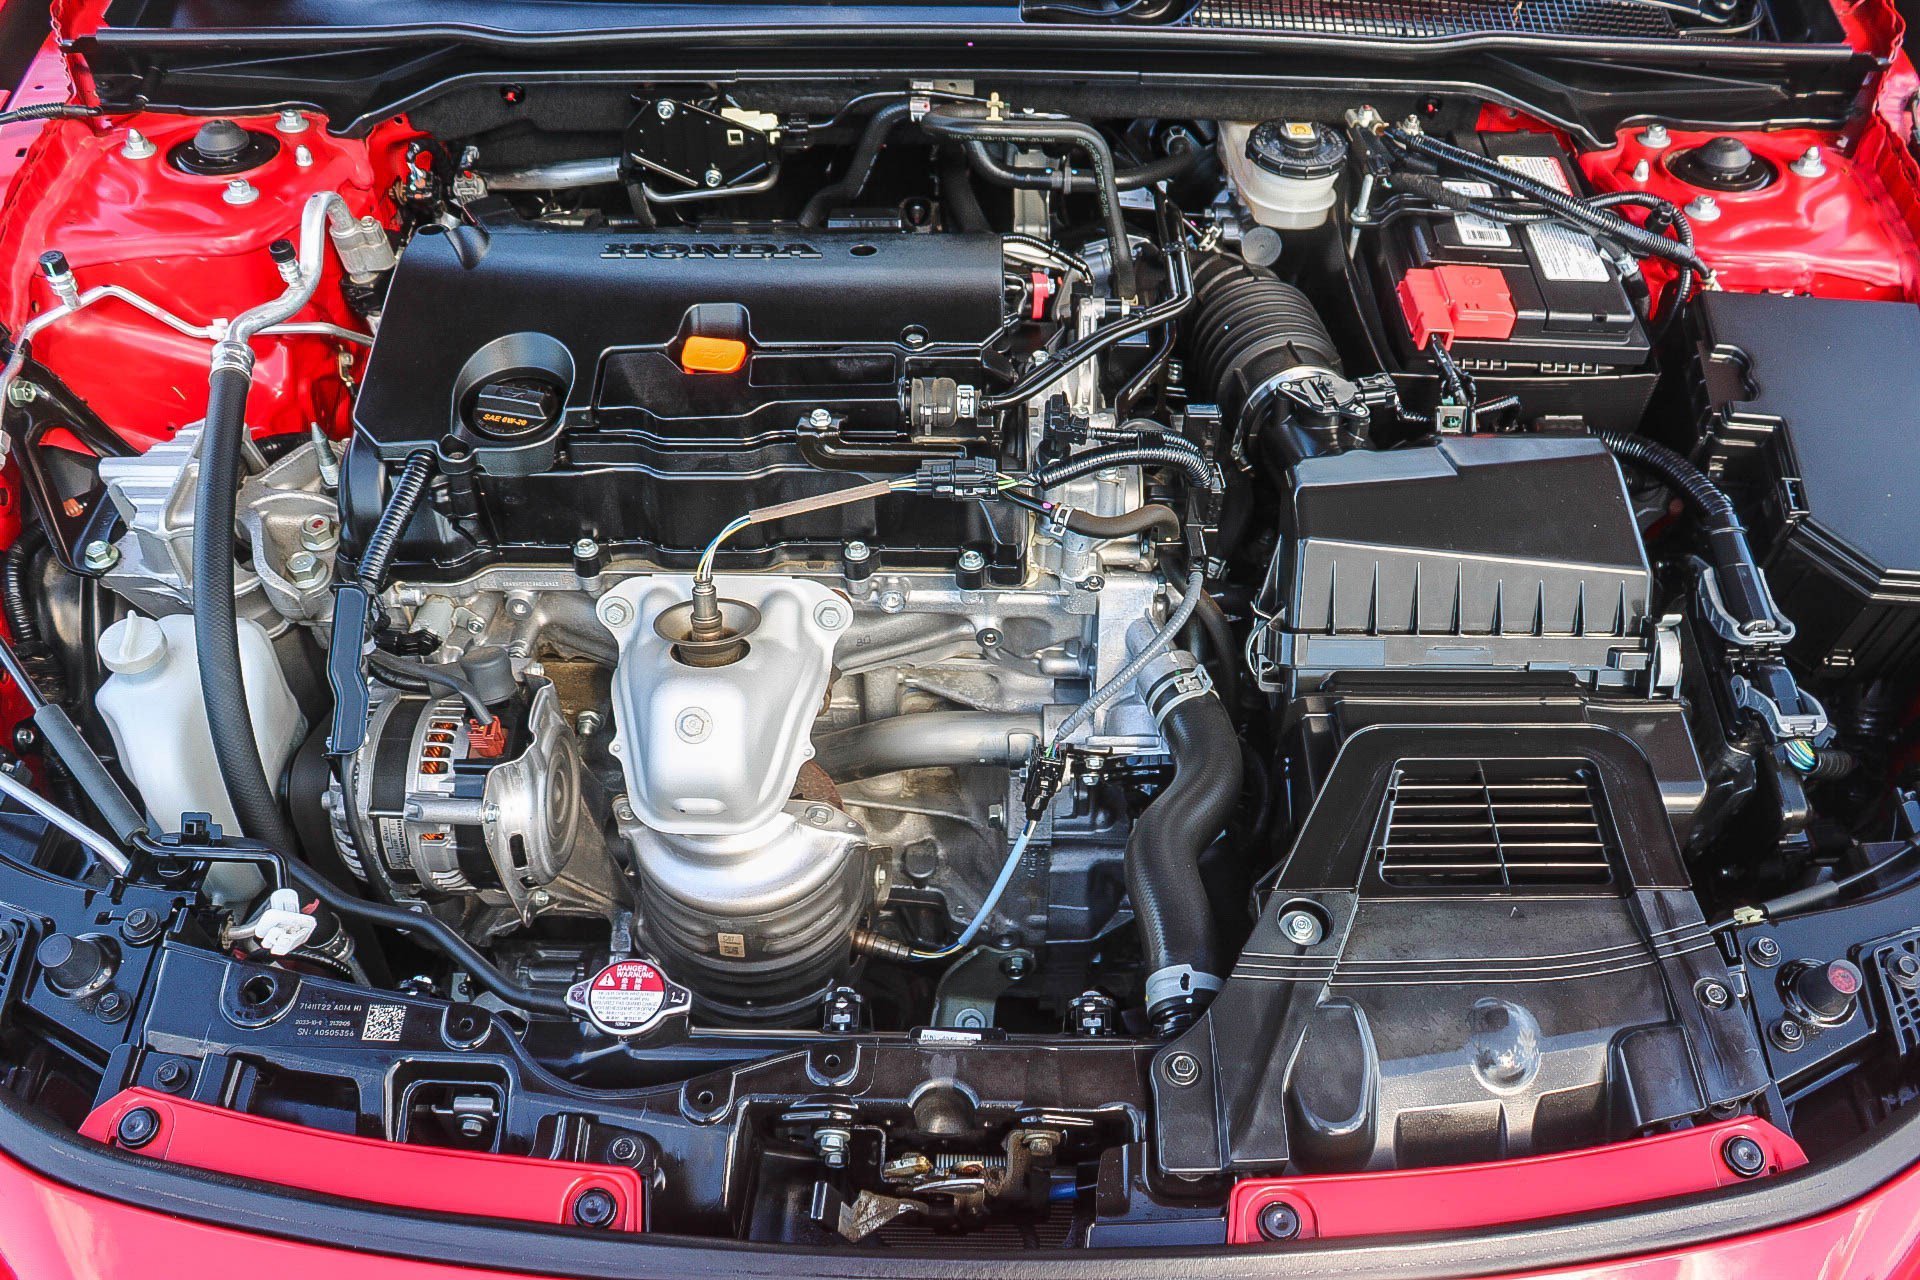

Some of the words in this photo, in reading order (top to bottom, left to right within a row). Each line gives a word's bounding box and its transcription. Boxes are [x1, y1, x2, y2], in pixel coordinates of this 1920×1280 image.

[600, 243, 823, 259] HONDA
[483, 413, 502, 422] SAE
[501, 416, 528, 427] 0W-20
[396, 820, 405, 848] HONDA
[616, 970, 654, 978] WARNING
